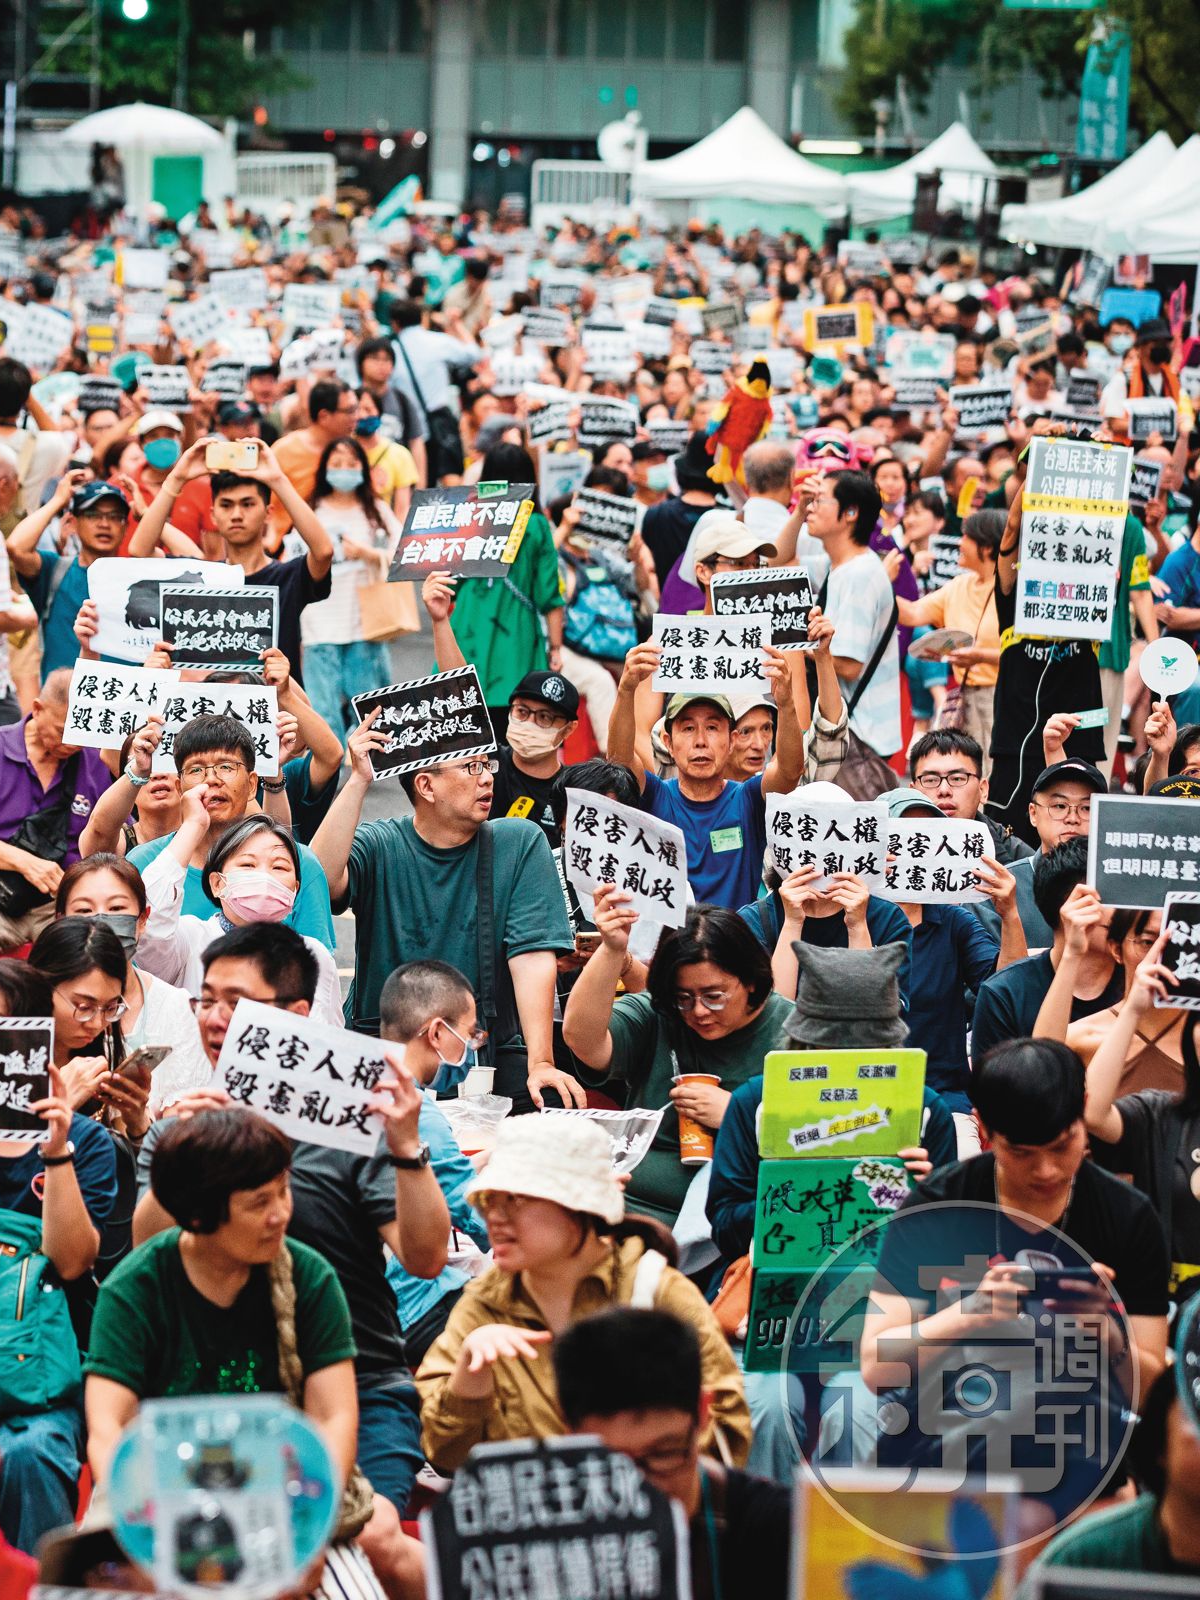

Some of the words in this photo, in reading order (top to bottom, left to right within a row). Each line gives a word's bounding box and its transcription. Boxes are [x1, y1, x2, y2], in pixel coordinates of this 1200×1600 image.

[411, 501, 519, 530] 國民黨不倒
[1030, 515, 1115, 541] 侵害人權
[401, 535, 509, 565] 台灣不會好
[1028, 540, 1114, 568] 毀憲亂政
[1024, 579, 1108, 603] 藍白紅亂搞
[1023, 601, 1089, 623] 都沒空吸
[660, 626, 763, 649] 侵害人權
[659, 655, 766, 680] 毀憲亂政
[70, 705, 149, 735] 毀憲亂
[574, 804, 680, 871] 侵害人權
[772, 811, 880, 843] 侵害人權
[570, 840, 675, 909] 毀憲亂政
[1102, 858, 1200, 881] 但明明是臺
[236, 1024, 386, 1090] 侵害人權
[789, 1066, 828, 1080] 反黑箱
[225, 1065, 373, 1136] 毀憲亂政
[819, 1088, 858, 1102] 反惡法
